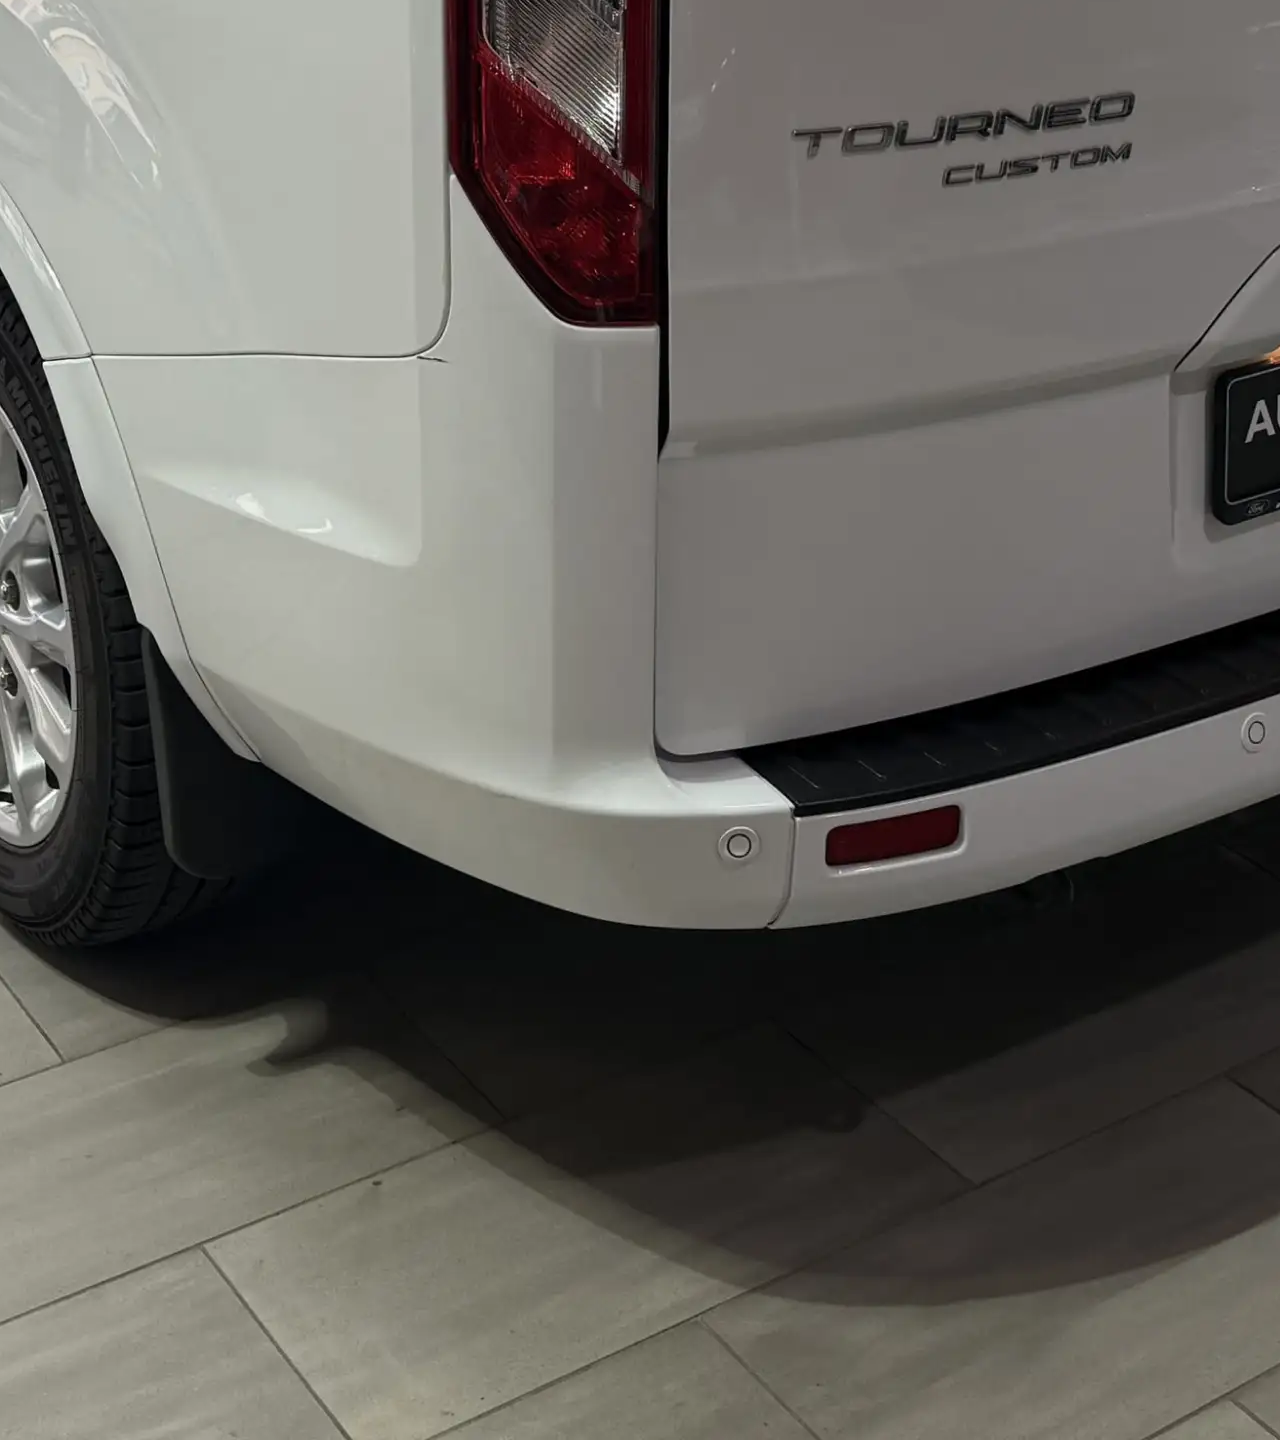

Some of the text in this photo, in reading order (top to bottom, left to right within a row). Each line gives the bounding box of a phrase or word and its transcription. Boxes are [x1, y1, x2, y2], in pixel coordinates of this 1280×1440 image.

[791, 91, 1136, 159] TOURNEO
[942, 141, 1133, 188] CUSTOM
[6, 375, 78, 547] MICHELIN
